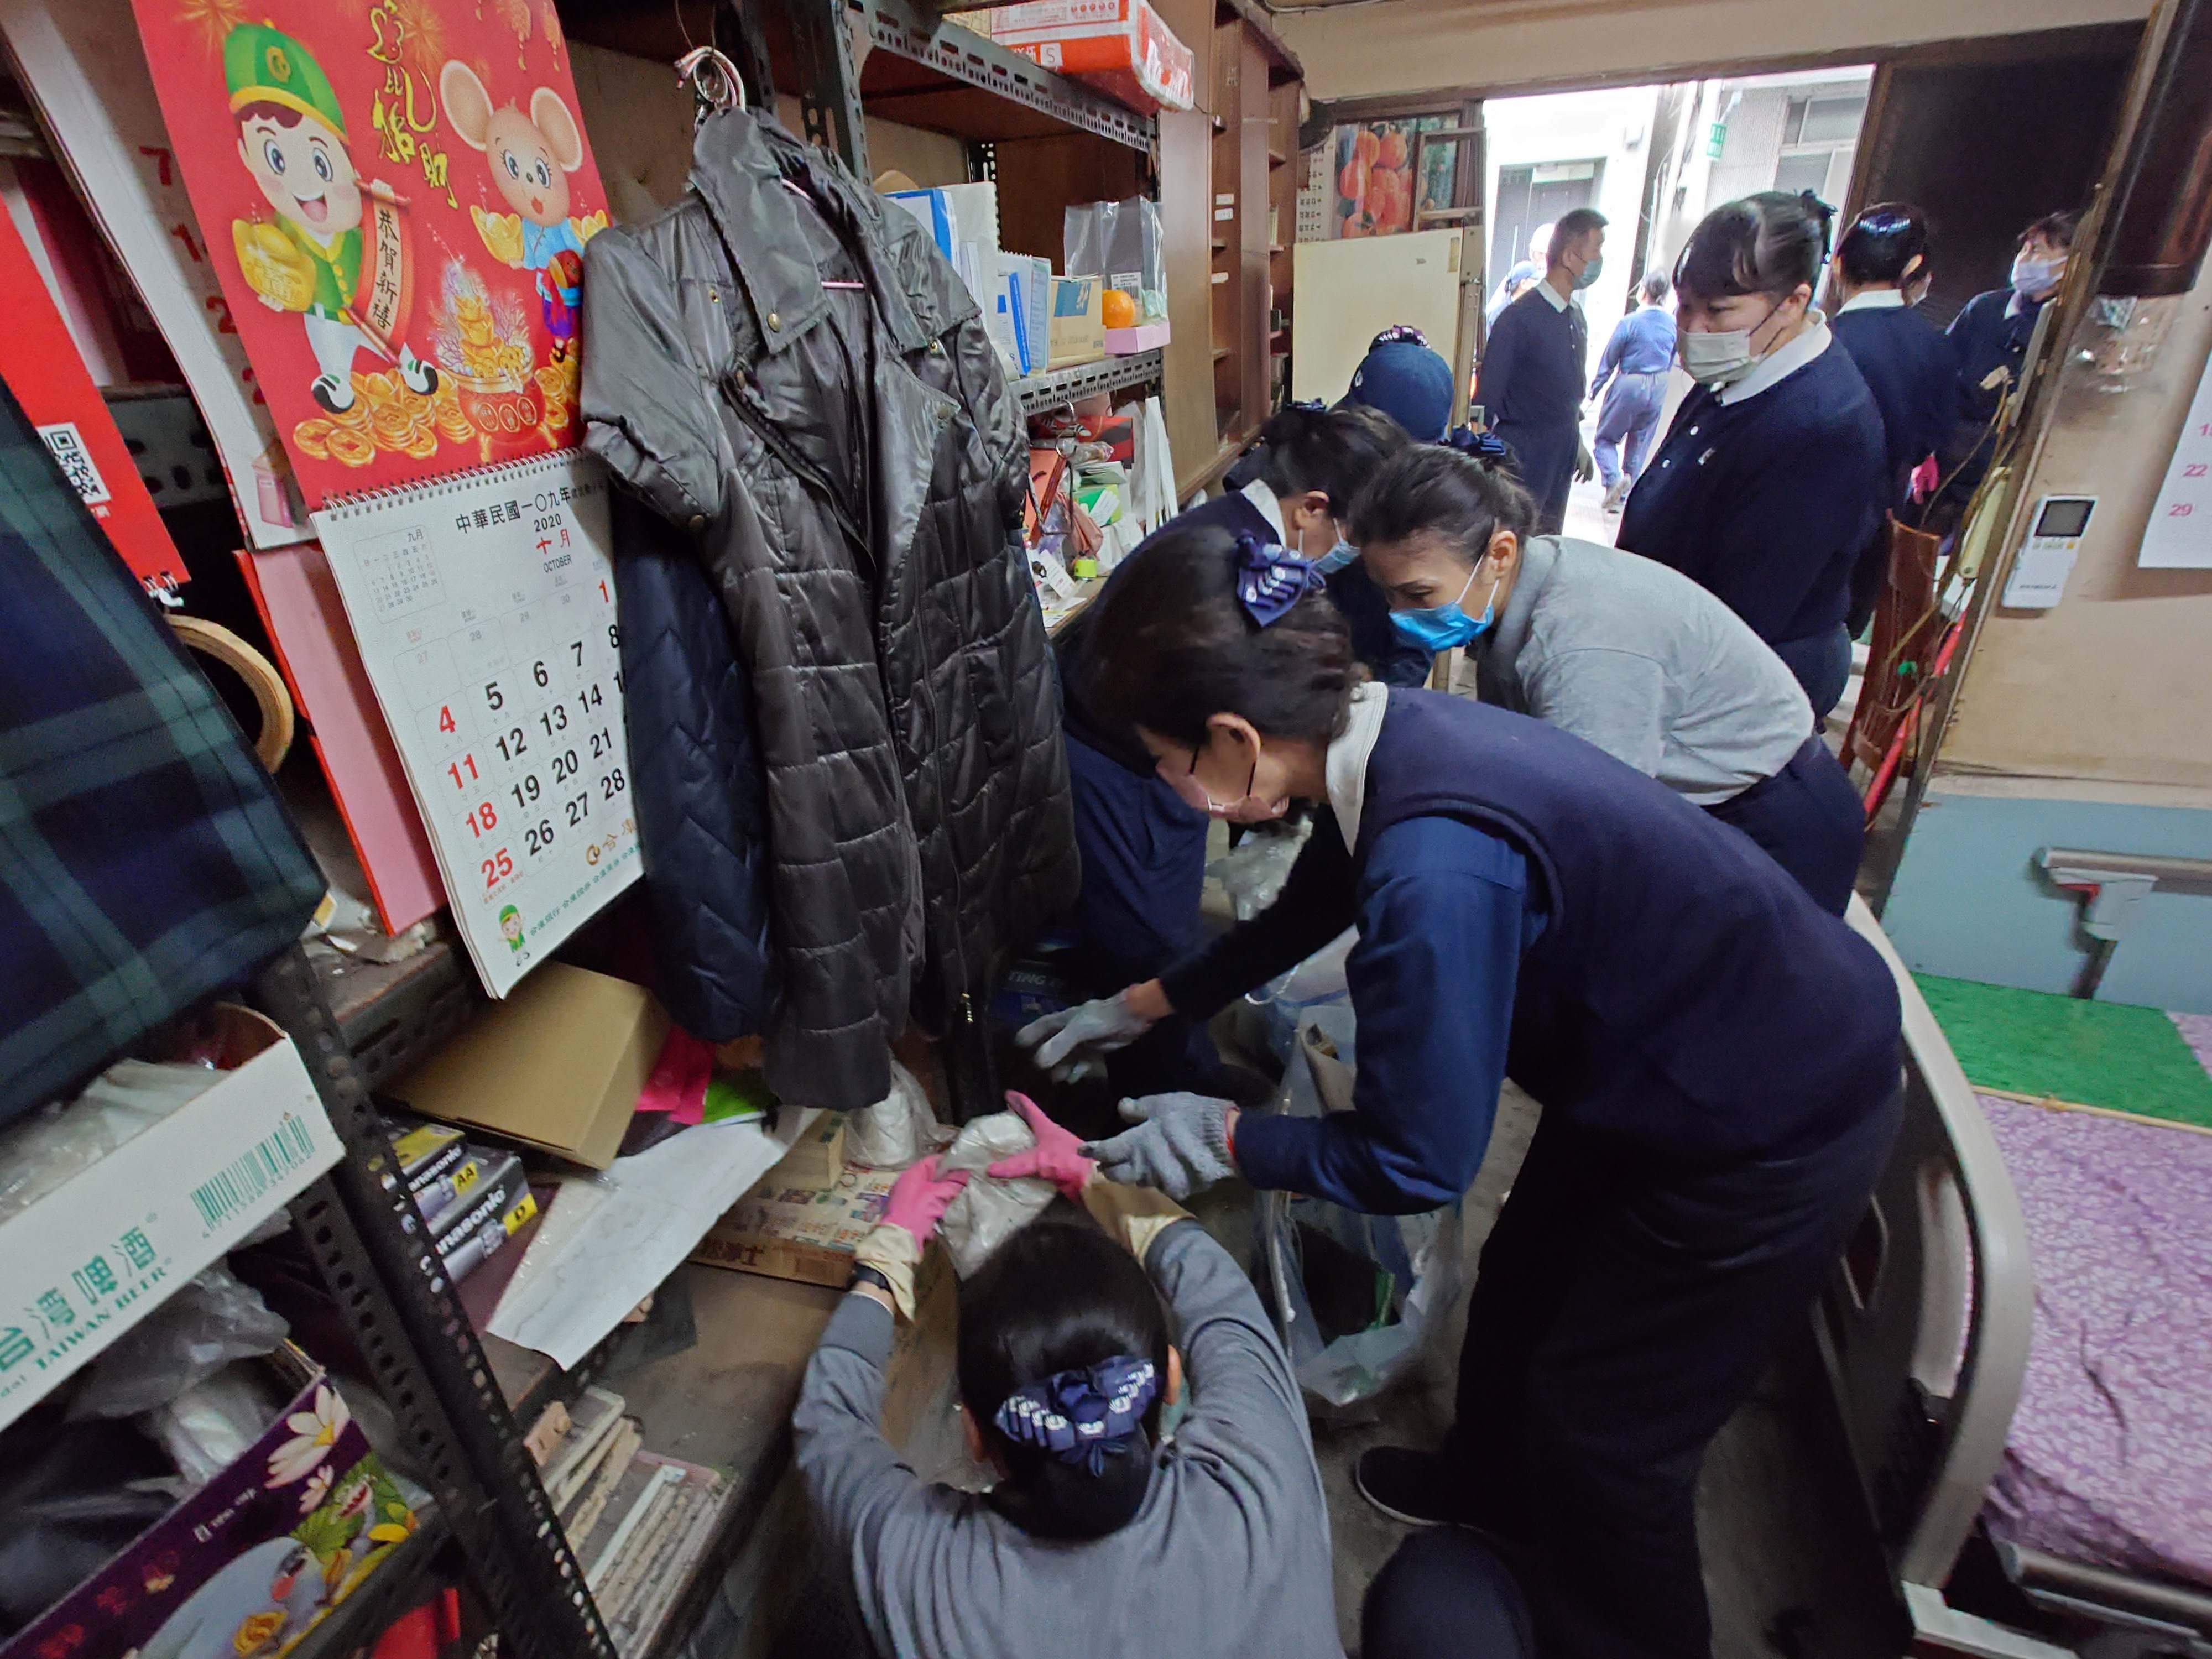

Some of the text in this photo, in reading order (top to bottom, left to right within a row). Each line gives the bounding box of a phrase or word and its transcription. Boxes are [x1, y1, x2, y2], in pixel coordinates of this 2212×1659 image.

[139, 145, 173, 186] 7
[170, 223, 206, 263] 1
[373, 209, 399, 330] 恭賀新禧
[2184, 464, 2208, 477] 22
[408, 529, 423, 542] 九月
[534, 513, 562, 533] 2020
[2169, 504, 2193, 517] 29
[544, 554, 572, 573] OCTOBER
[469, 630, 482, 642] 28
[561, 593, 570, 605] 30
[599, 578, 609, 603] 1
[440, 624, 620, 733] 4 5 6 7 8
[447, 753, 479, 790] 11
[496, 727, 528, 761] 12
[540, 705, 567, 737] 13
[578, 683, 602, 713] 14
[466, 802, 497, 838] 18
[511, 775, 540, 808] 19
[552, 749, 578, 785] 20
[590, 727, 612, 759] 21
[481, 768, 625, 890] 25 26 27 28
[0, 1226, 157, 1371] 台灣啤酒
[35, 1266, 167, 1370] TAIWAN BEER
